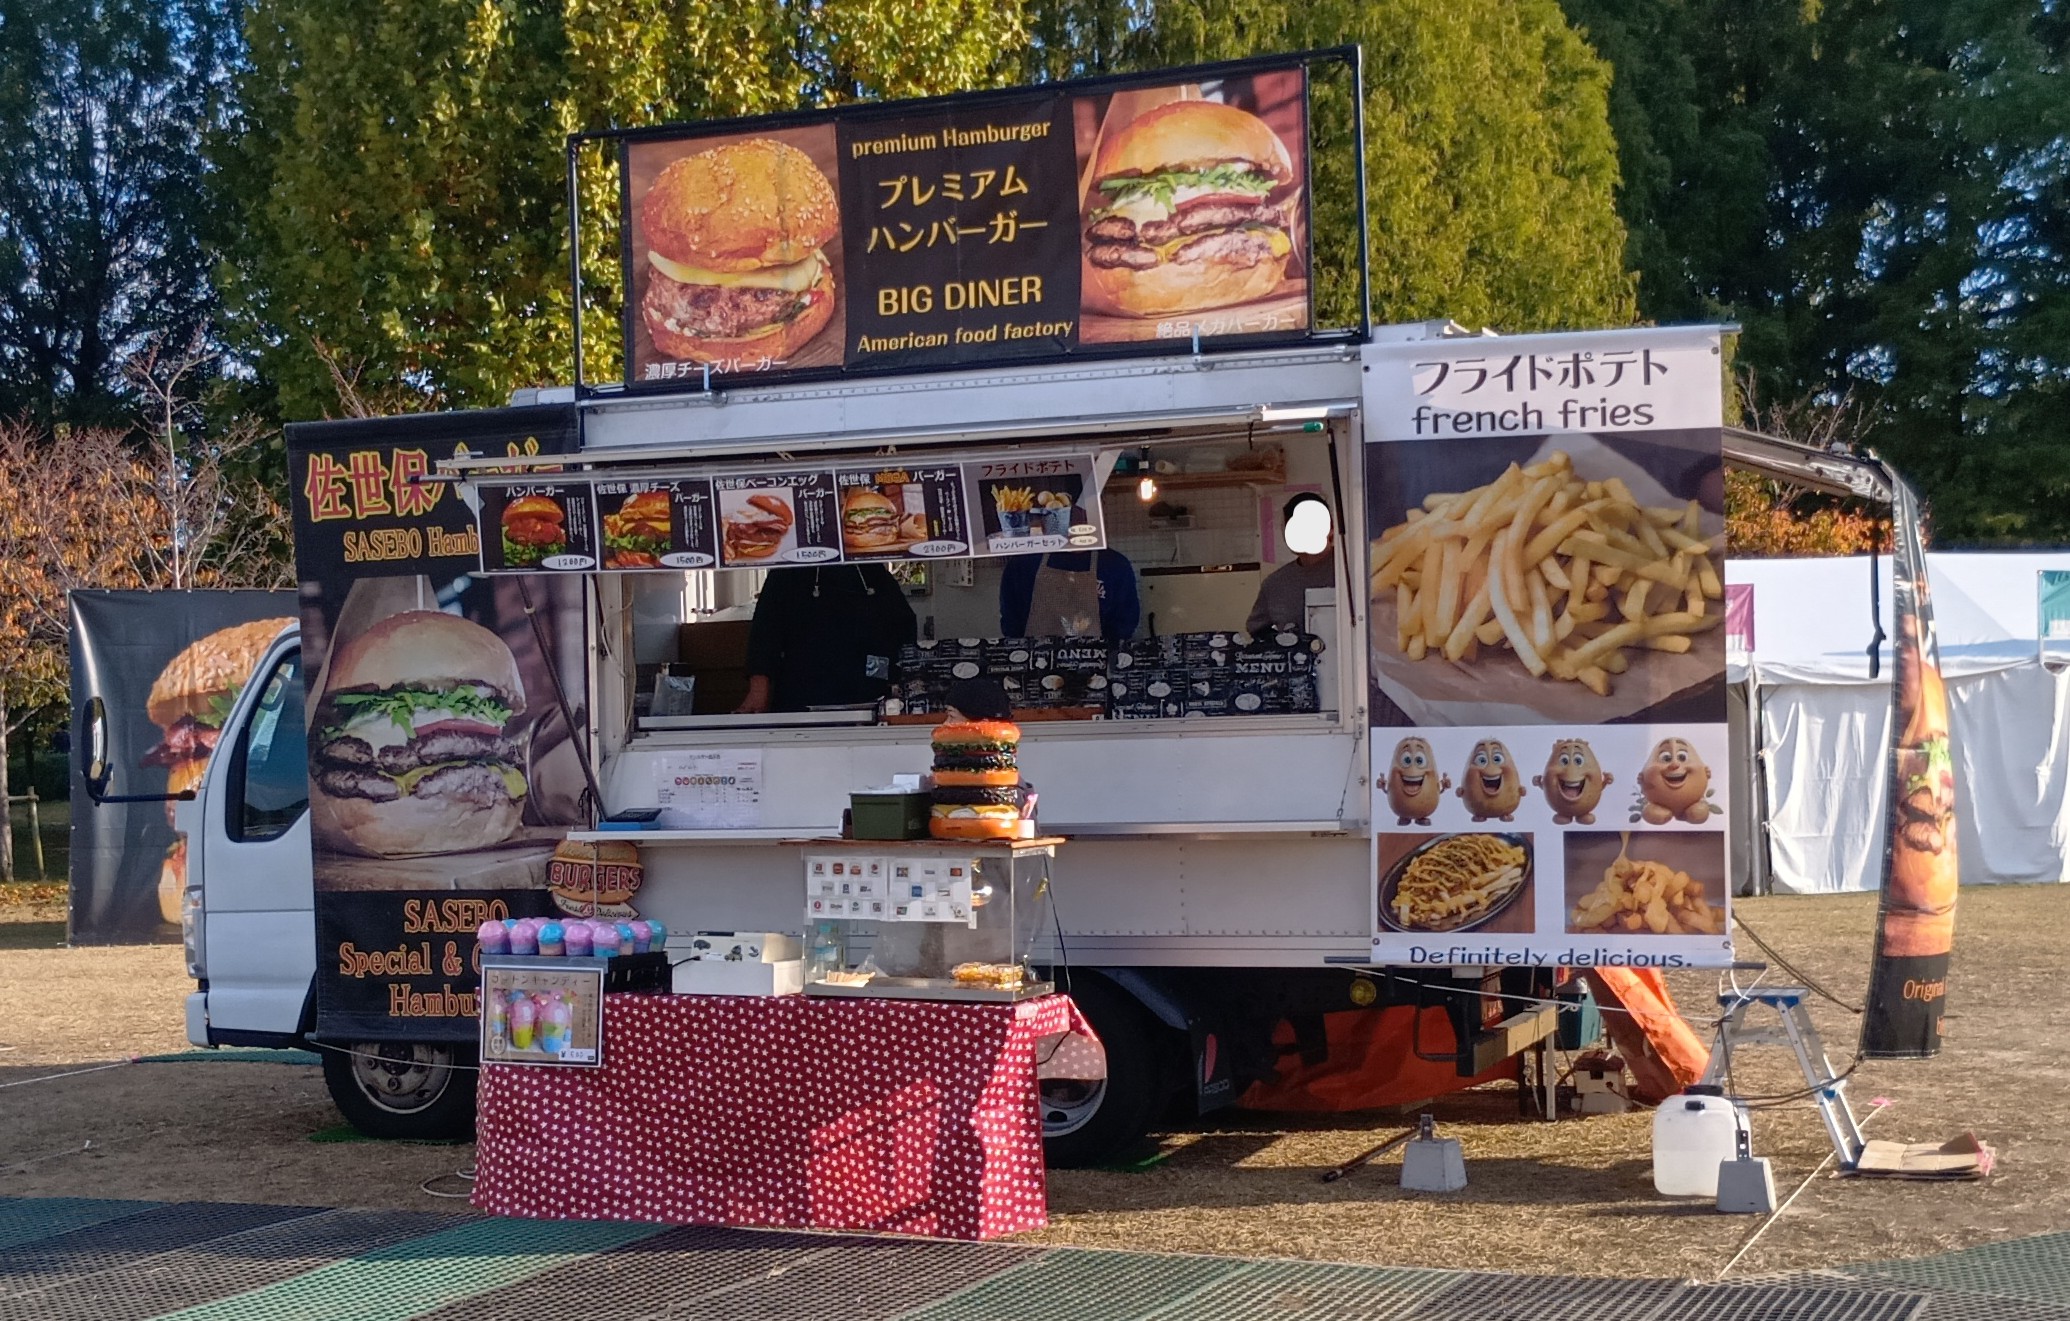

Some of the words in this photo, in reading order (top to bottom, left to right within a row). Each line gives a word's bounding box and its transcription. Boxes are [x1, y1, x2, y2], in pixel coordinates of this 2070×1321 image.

[852, 133, 936, 159] premium
[943, 121, 1052, 148] Hamburger
[878, 164, 1029, 209] プレミアム
[866, 209, 1049, 254] ハンバーガー
[878, 285, 933, 316] BIG
[944, 275, 1043, 311] DINER
[857, 332, 949, 353] American
[955, 324, 998, 344] food
[1003, 320, 1073, 338] factory
[645, 356, 788, 381] 濃厚チーズバーガー
[1414, 348, 1669, 396] フライドポテト
[1412, 401, 1543, 435] french
[1558, 397, 1655, 428] fries
[913, 470, 957, 482] バーガー
[981, 459, 1075, 478] フライドポテト
[505, 486, 565, 498] ハンバーガー
[674, 491, 708, 503] バーガー
[798, 488, 834, 499] バーガー
[343, 527, 423, 562] SASEBO
[995, 538, 1065, 550] ハンバーガーセット
[1235, 662, 1286, 674] MENU
[550, 862, 641, 893] BURGERS
[339, 942, 433, 978] Special
[442, 940, 463, 976] &
[1409, 945, 1548, 967] Definitely
[1557, 945, 1693, 967] delicious.
[388, 983, 480, 1018] Hambu
